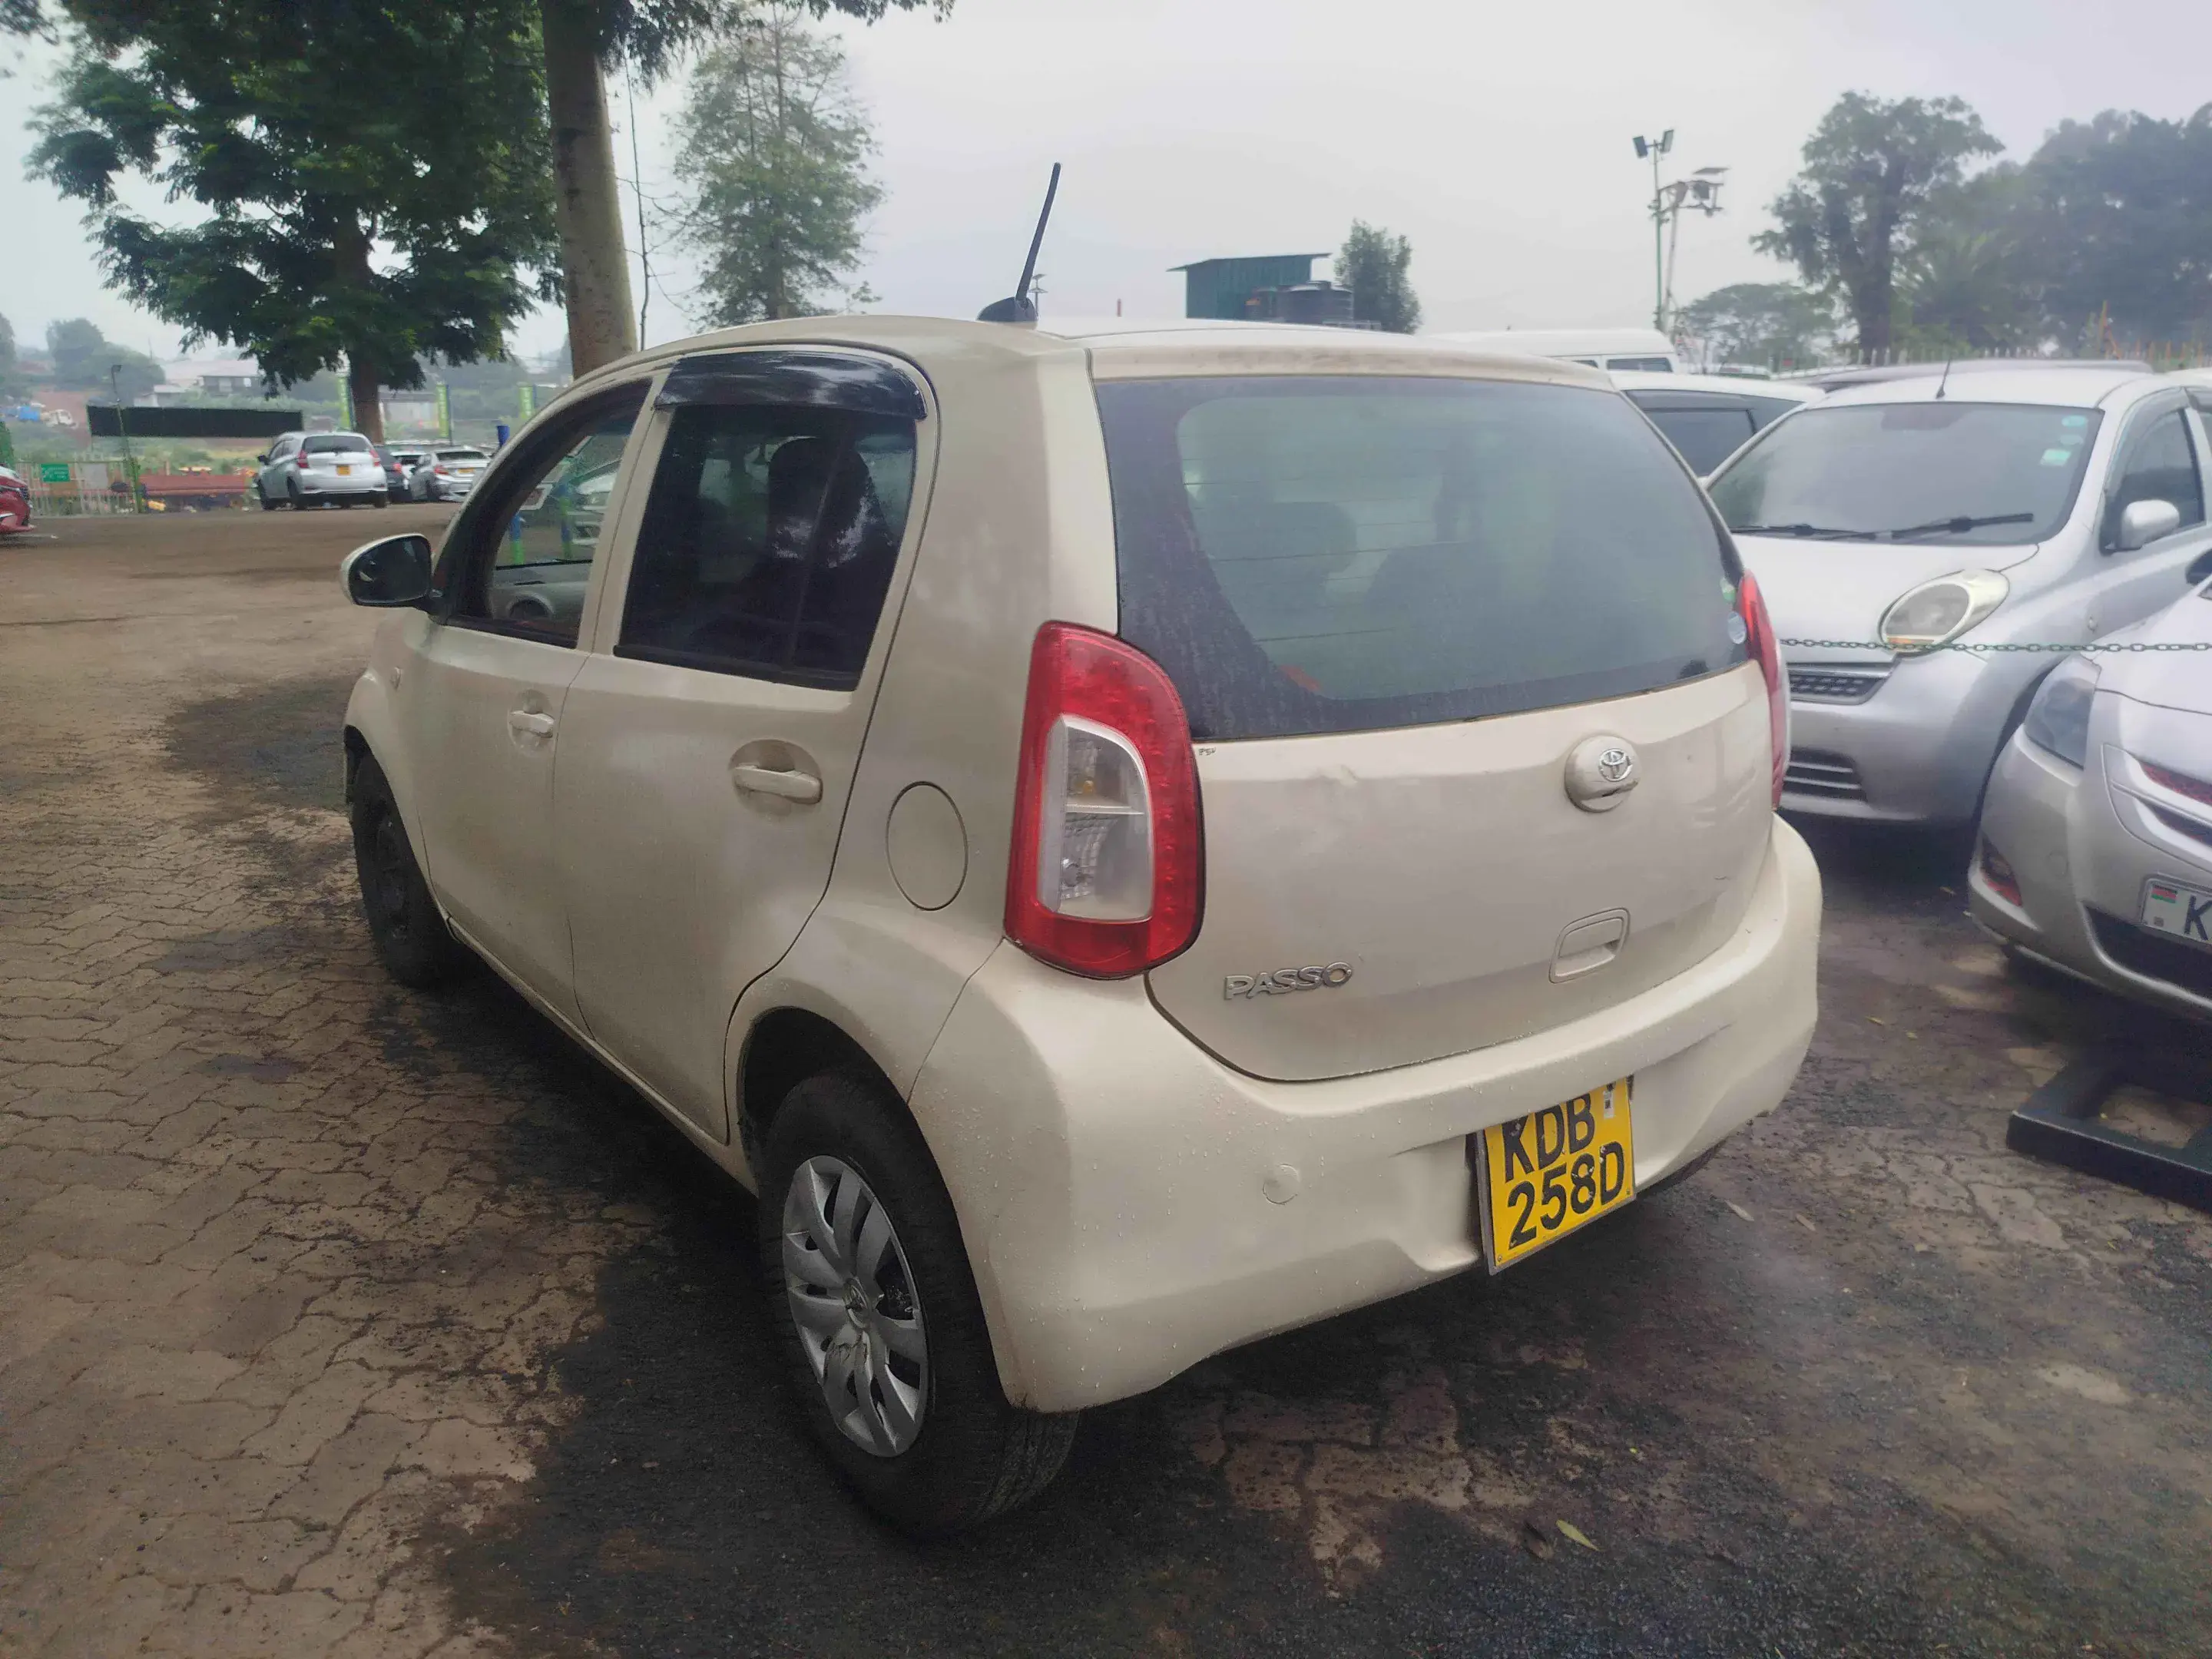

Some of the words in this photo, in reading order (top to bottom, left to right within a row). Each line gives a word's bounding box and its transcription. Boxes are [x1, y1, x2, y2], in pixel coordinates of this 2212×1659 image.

[2184, 894, 2212, 941] K
[1224, 962, 1353, 1000] PASSO
[1502, 1093, 1595, 1184] KDB
[1507, 1141, 1625, 1250] 258D
